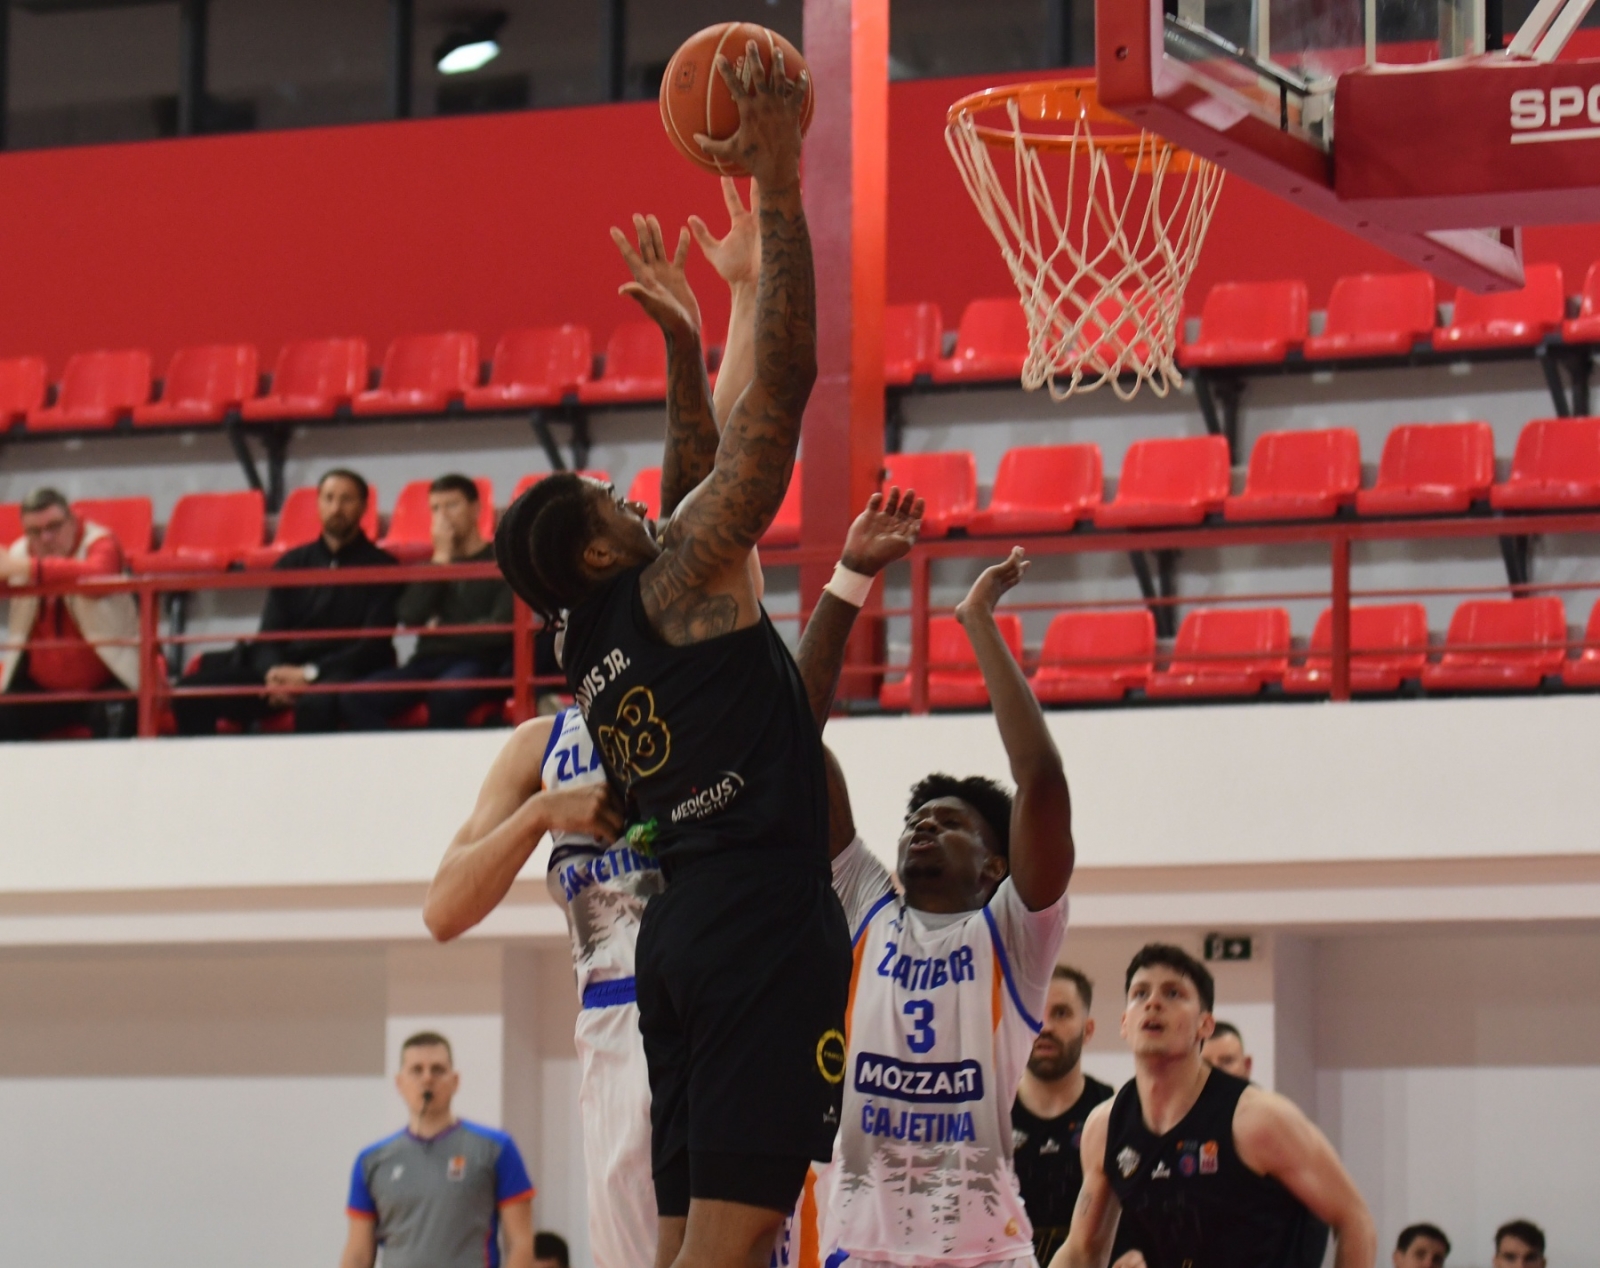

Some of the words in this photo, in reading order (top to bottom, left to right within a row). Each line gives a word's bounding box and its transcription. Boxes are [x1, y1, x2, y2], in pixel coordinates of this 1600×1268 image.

[576, 665, 606, 721] AVIS
[602, 647, 631, 682] JR.
[671, 777, 734, 824] MEDICUS
[876, 941, 976, 992] ZATIBOR
[903, 999, 936, 1054] 3
[858, 1060, 977, 1095] MOZZART
[861, 1099, 977, 1143] ČAJETINA
